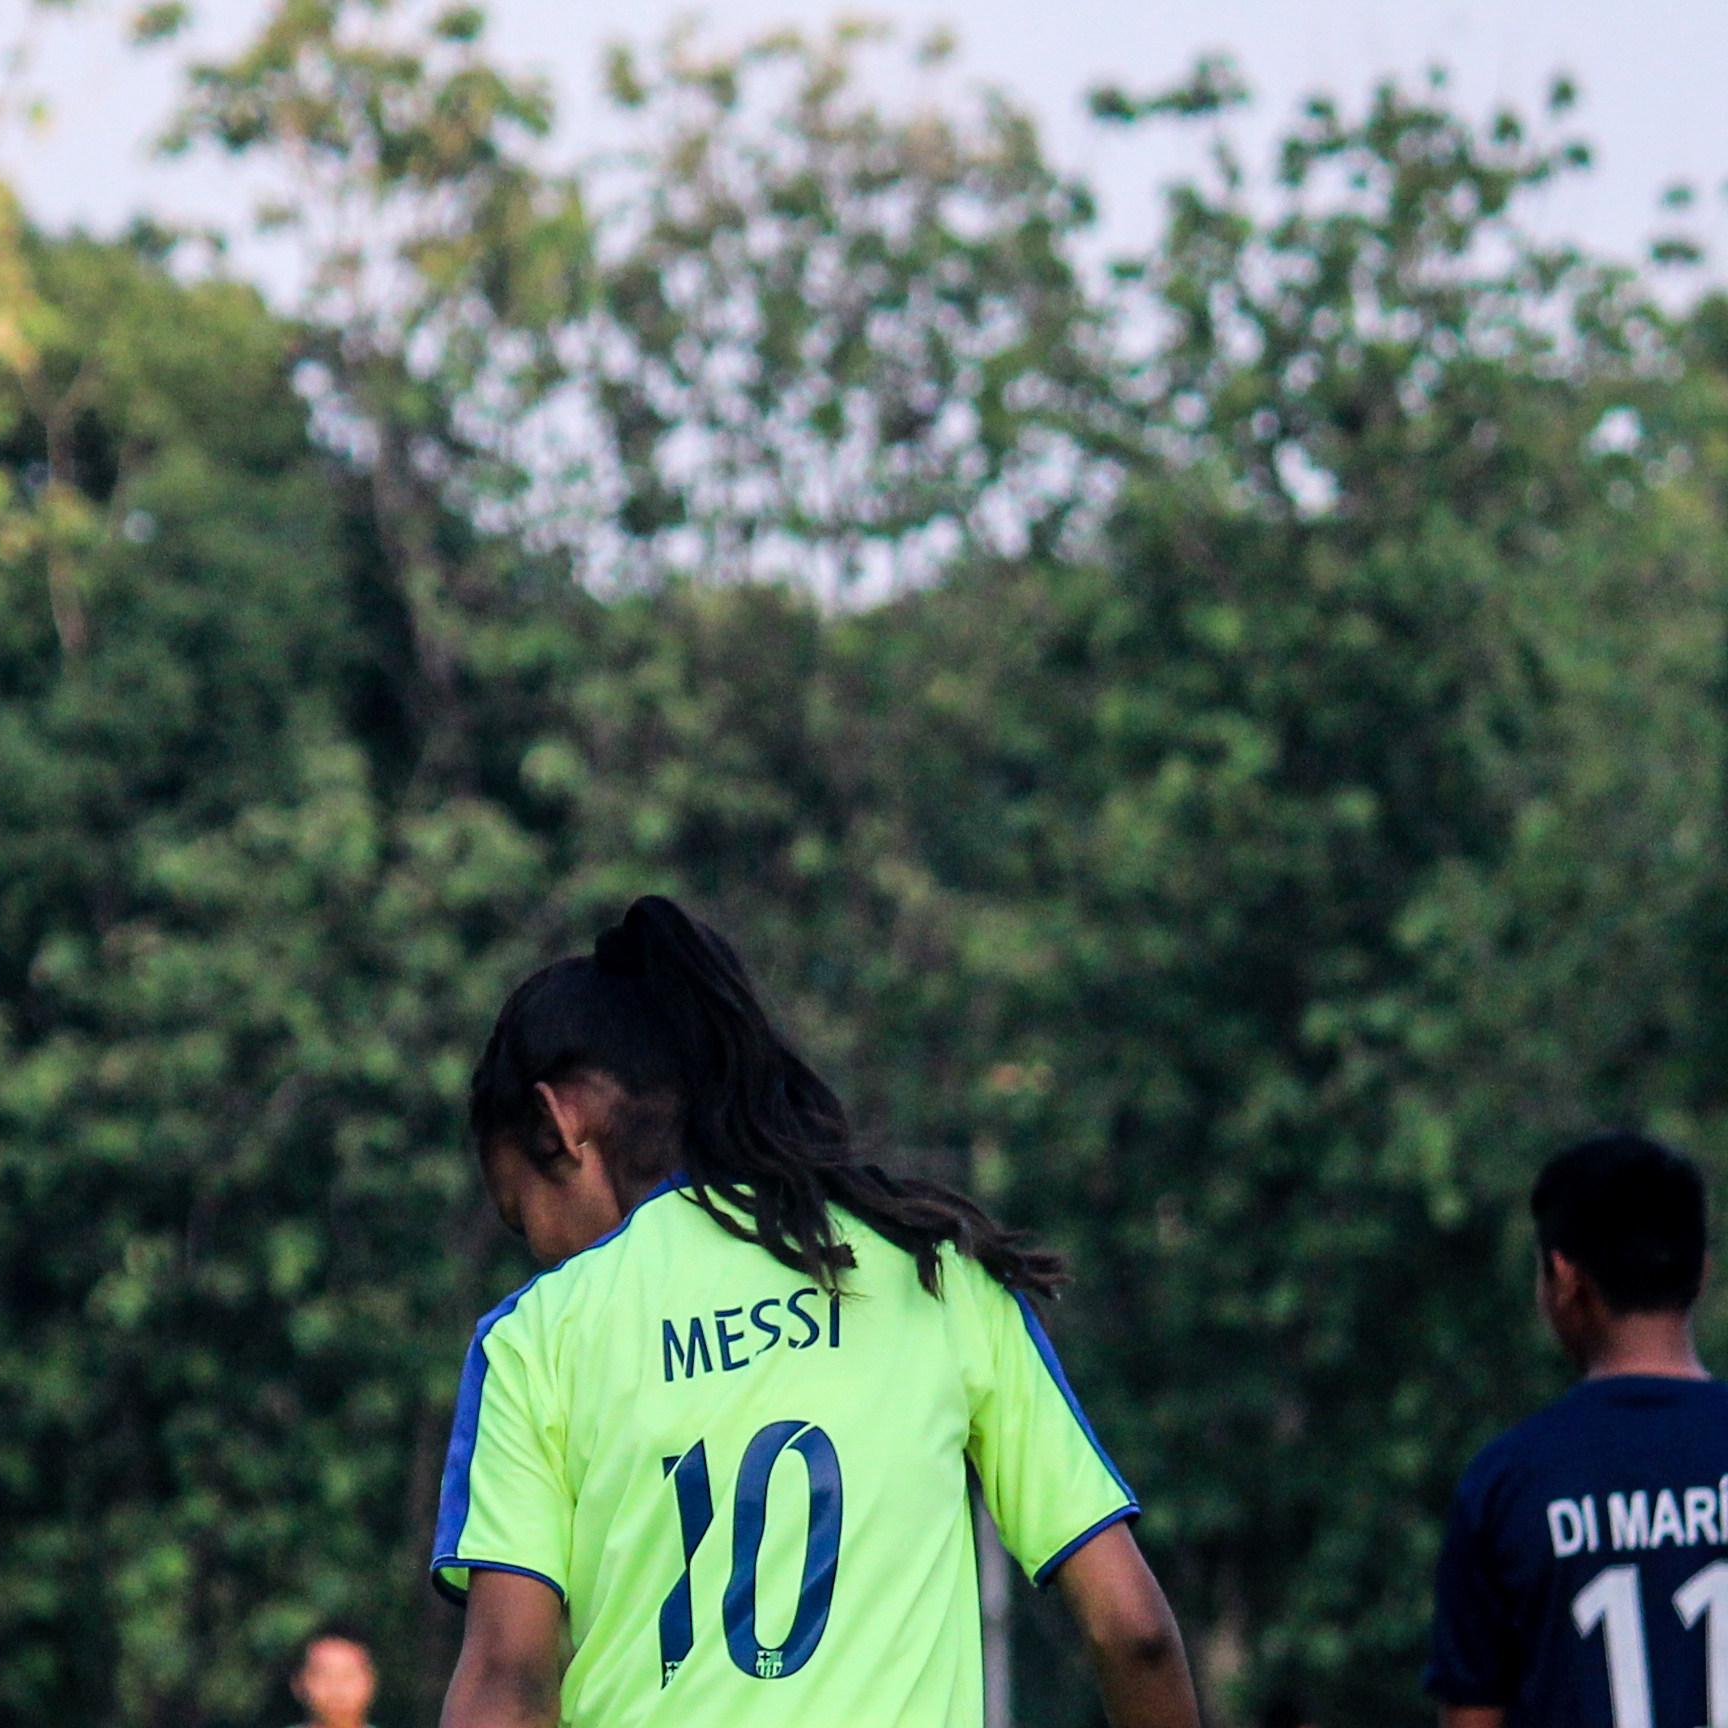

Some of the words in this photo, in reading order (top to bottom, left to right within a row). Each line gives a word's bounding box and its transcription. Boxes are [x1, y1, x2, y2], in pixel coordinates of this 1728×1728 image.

[662, 1288, 840, 1381] MESSI
[659, 1420, 843, 1689] 10
[1546, 1495, 1600, 1557] DI
